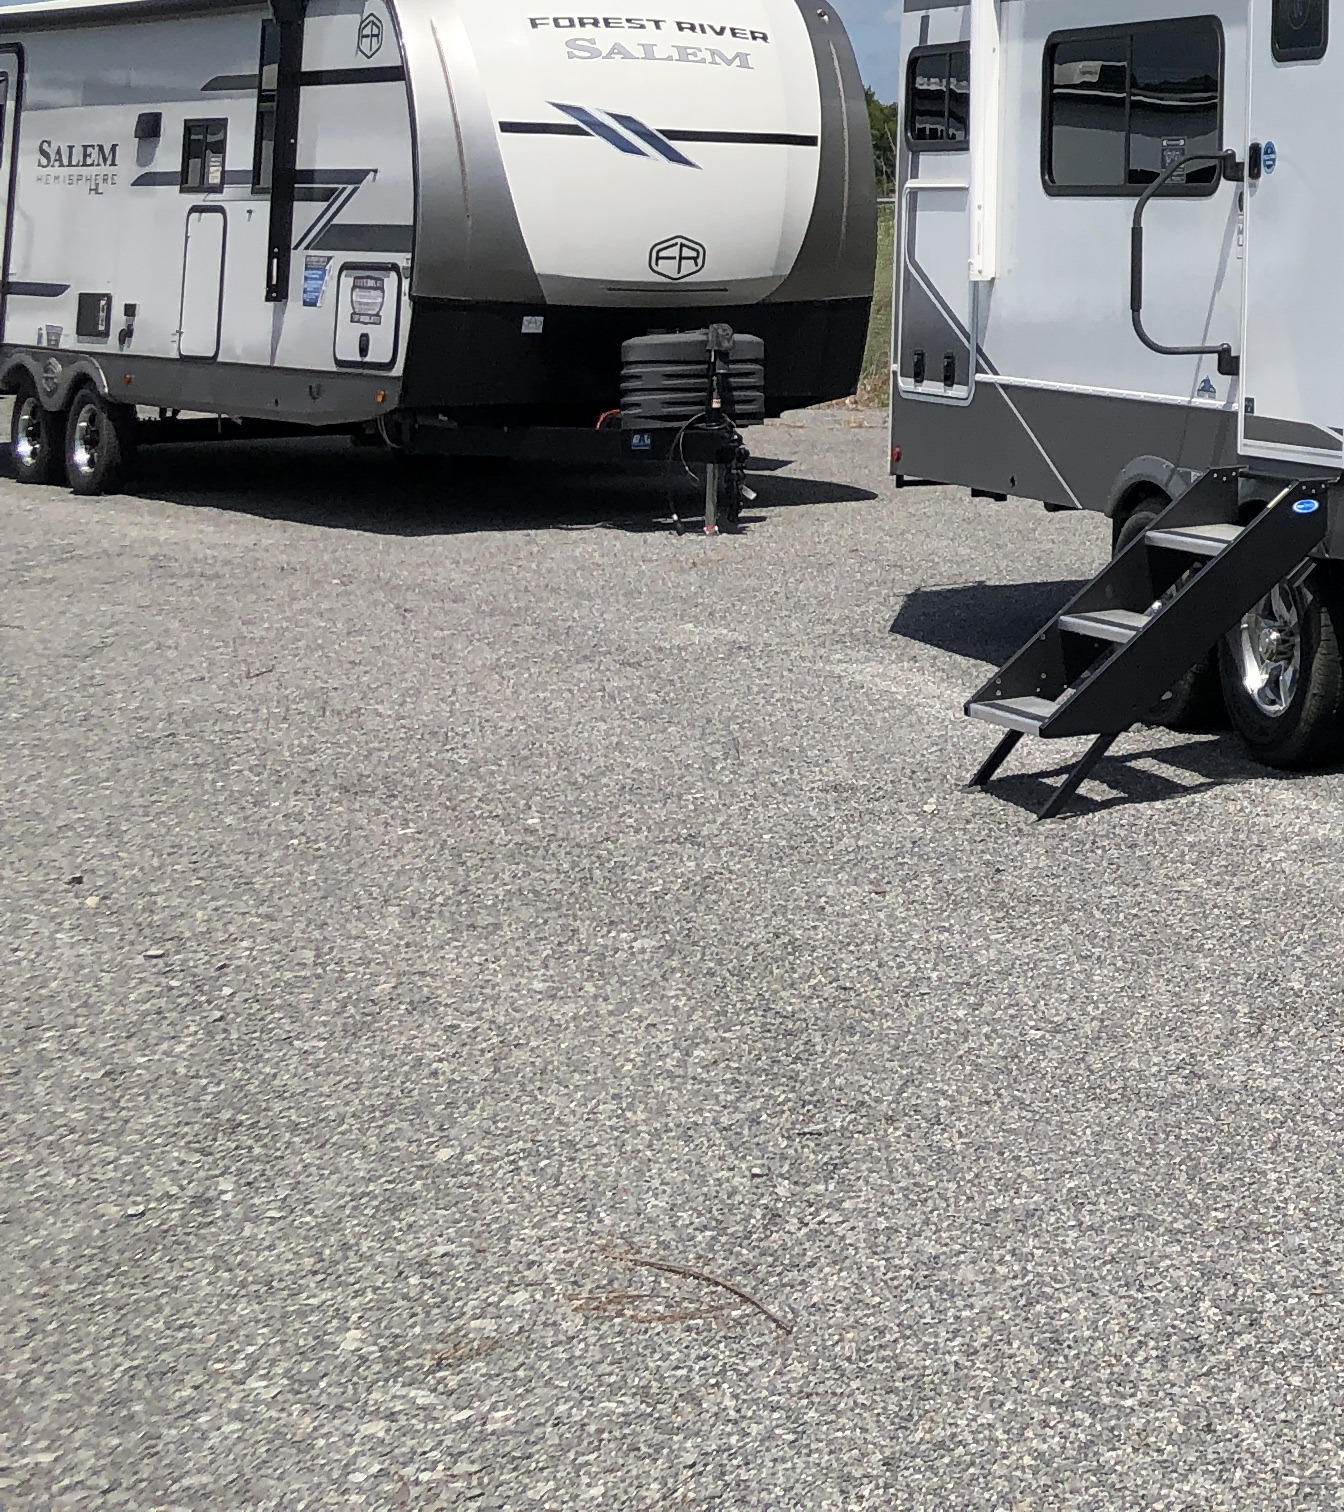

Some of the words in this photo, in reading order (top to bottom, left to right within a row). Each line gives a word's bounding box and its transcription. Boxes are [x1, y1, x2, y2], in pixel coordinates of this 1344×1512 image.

[527, 16, 667, 31] FOREST
[674, 20, 771, 44] RIVER
[564, 37, 755, 70] SALEM
[37, 139, 119, 169] SALEM
[36, 173, 118, 186] HEMISPHERE
